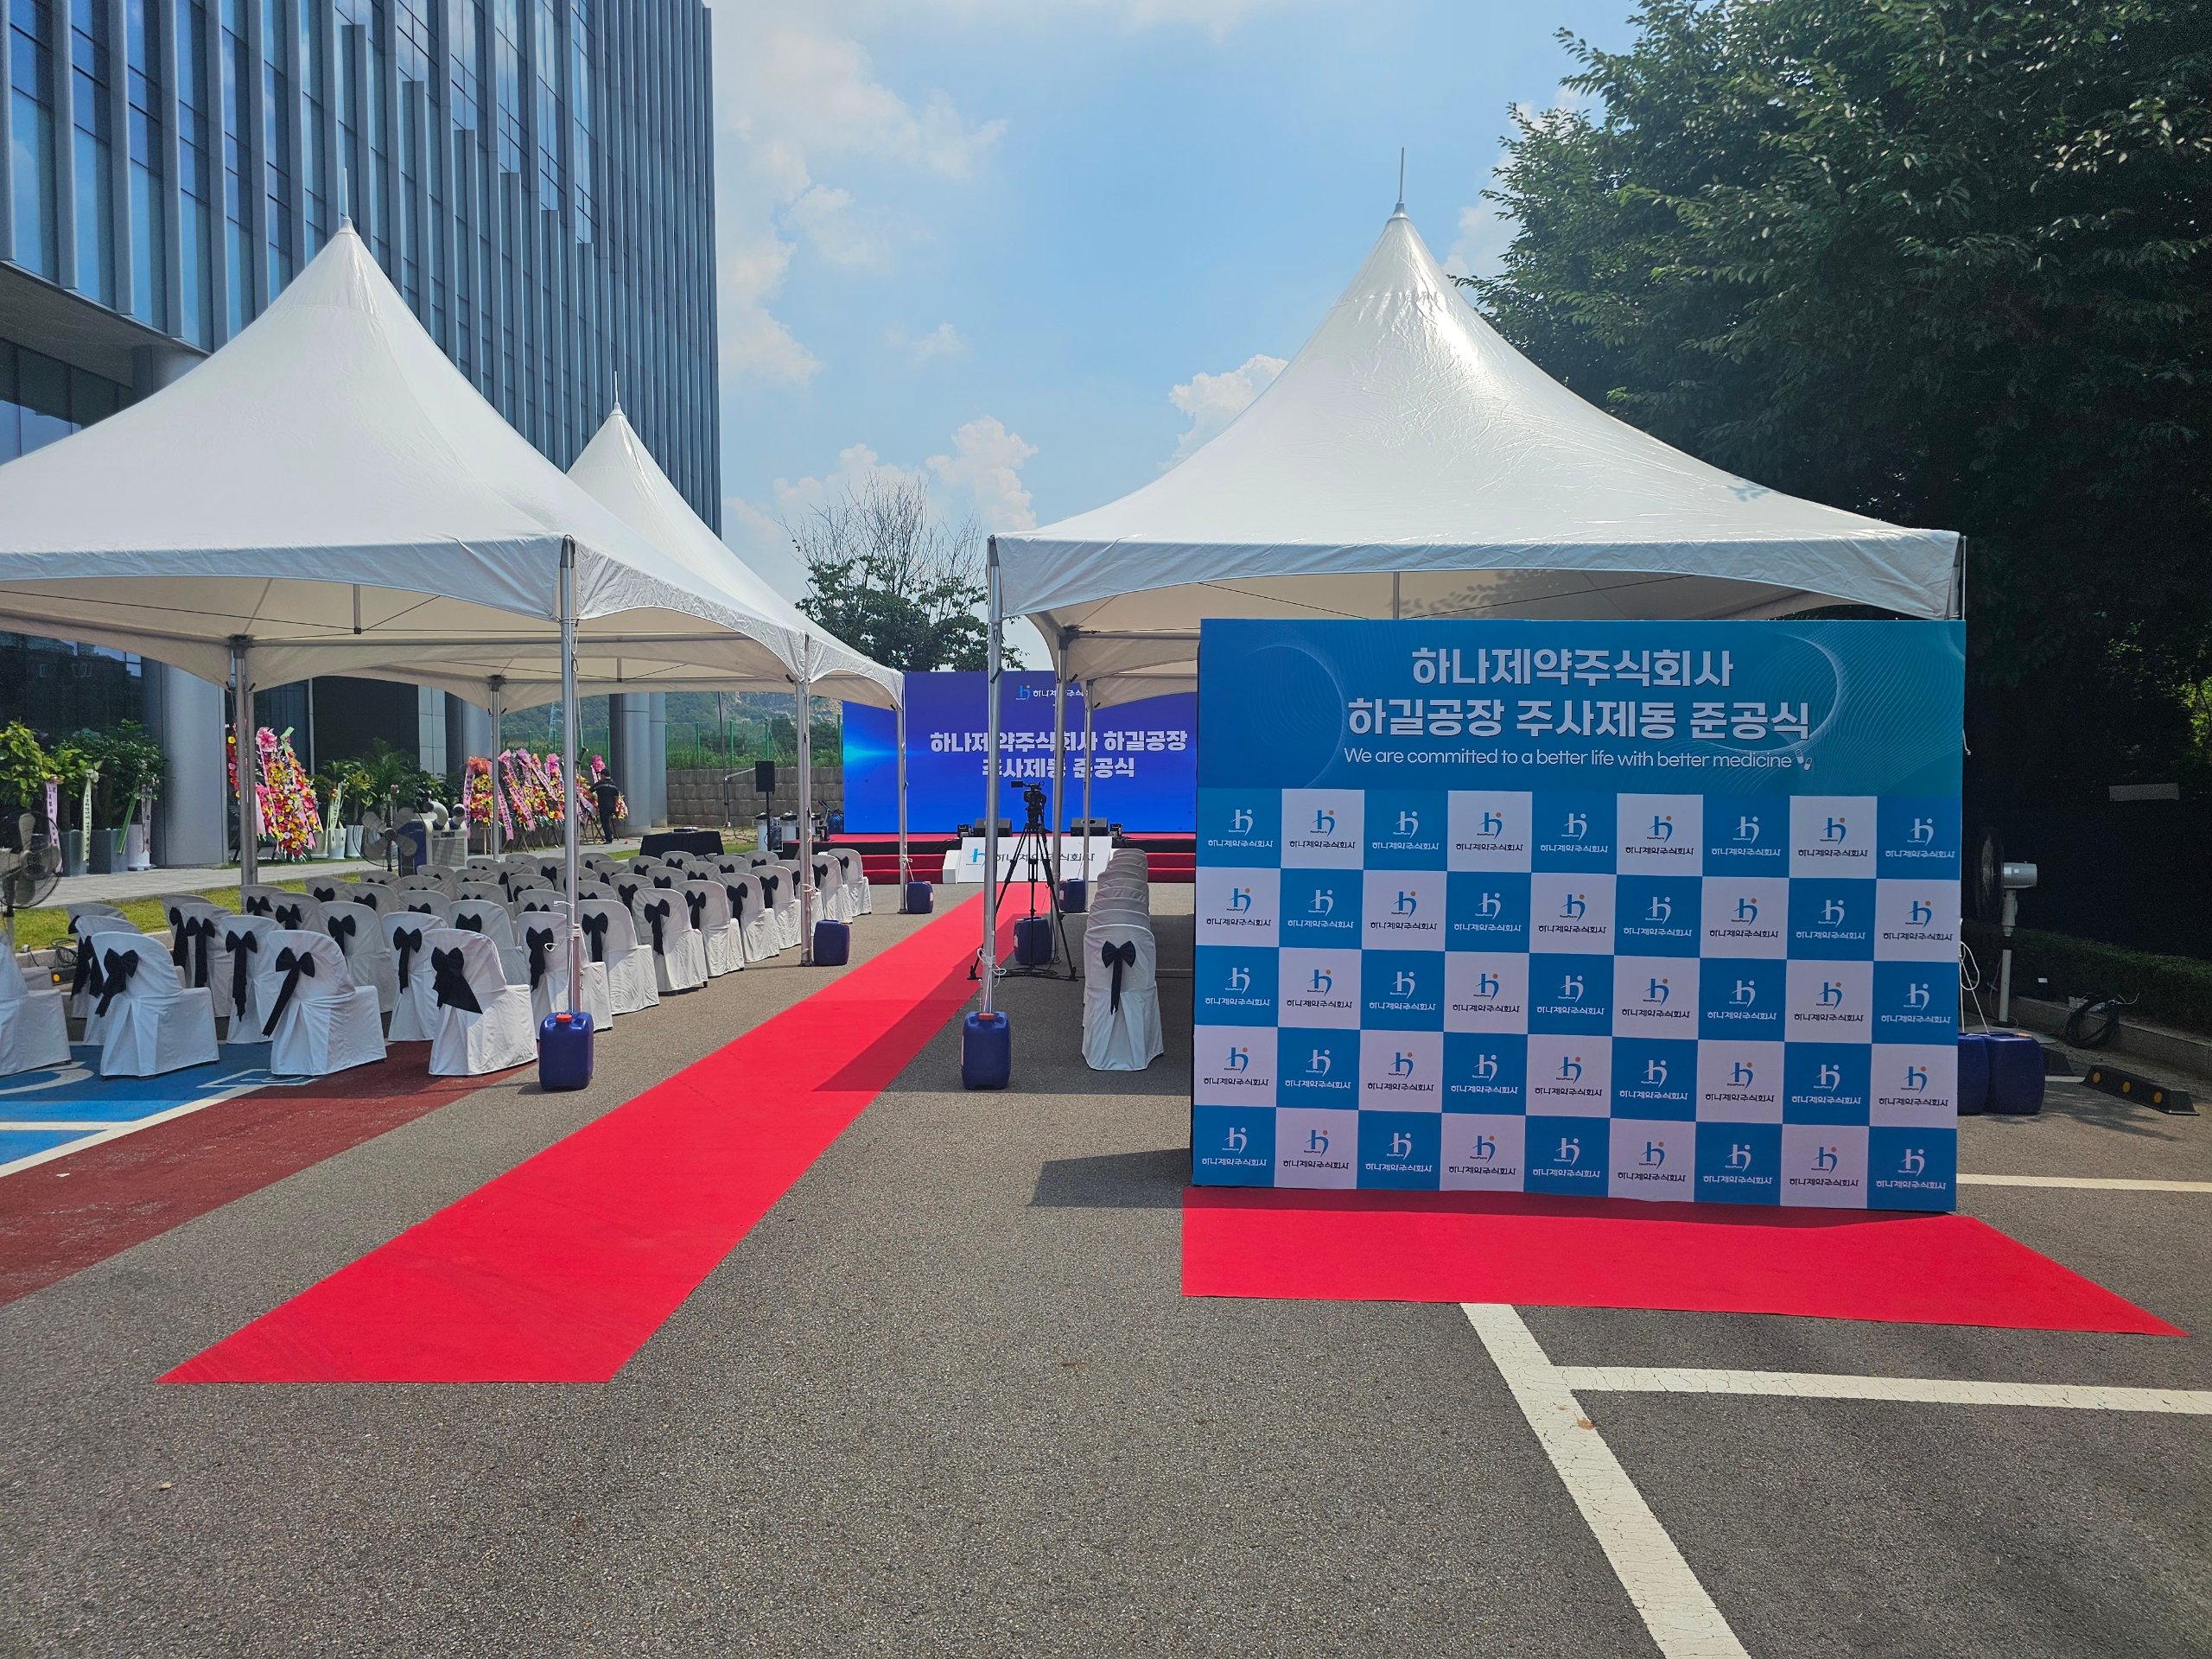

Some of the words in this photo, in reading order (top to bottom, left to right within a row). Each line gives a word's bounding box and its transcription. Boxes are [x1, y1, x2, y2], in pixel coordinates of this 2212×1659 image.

[1411, 646, 1734, 687] 하나제약주식회사
[1348, 697, 1505, 737] 하길공장
[1516, 700, 1676, 740] 주사제동
[1690, 701, 1809, 741] 준공식
[1103, 730, 1188, 752] 하길공장
[1344, 747, 1372, 763] We
[1375, 751, 1404, 764] are
[1408, 747, 1498, 765] committed
[1501, 749, 1518, 765] to
[1521, 752, 1533, 765] a
[1536, 748, 1588, 766] better
[1591, 749, 1615, 766] life
[1618, 750, 1654, 766] with
[1657, 751, 1711, 767] better
[1713, 751, 1793, 768] medicine
[1207, 839, 1274, 848] 하나제약주식회사
[1289, 840, 1356, 849] 하나제약주식회사
[1371, 842, 1440, 850] 하나제약주식회사
[1540, 844, 1609, 854] 하나제약주식회사
[1624, 846, 1694, 855] 하나제약주식회사
[1711, 848, 1782, 856] 하나제약주식회사
[1885, 849, 1955, 859] 하나제약주식회사
[1206, 918, 1272, 926] 하나제약주식회사
[1287, 919, 1355, 929] 하나제약주식회사
[1370, 922, 1438, 931] 하나제약주식회사
[1453, 923, 1522, 932] 하나제약주식회사
[1538, 925, 1607, 934] 하나제약주식회사
[1623, 927, 1693, 937] 하나제약주식회사
[1709, 930, 1779, 938] 하나제약주식회사
[1796, 931, 1866, 940] 하나제약주식회사
[1883, 932, 1954, 941] 하나제약주식회사
[1205, 997, 1271, 1007] 하나제약주식회사
[1286, 999, 1353, 1008] 하나제약주식회사
[1369, 1001, 1436, 1011] 하나제약주식회사
[1452, 1004, 1521, 1013] 하나제약주식회사
[1536, 1006, 1605, 1015] 하나제약주식회사
[1621, 1008, 1691, 1019] 하나제약주식회사
[1707, 1011, 1777, 1020] 하나제약주식회사
[1793, 1013, 1864, 1022] 하나제약주식회사
[1880, 1014, 1952, 1024] 하나제약주식회사
[1203, 1077, 1269, 1086] 하나제약주식회사
[1285, 1079, 1351, 1089] 하나제약주식회사
[1367, 1082, 1434, 1091] 하나제약주식회사
[1450, 1084, 1519, 1094] 하나제약주식회사
[1535, 1087, 1603, 1096] 하나제약주식회사
[1618, 1090, 1688, 1100] 하나제약주식회사
[1705, 1093, 1775, 1103] 하나제약주식회사
[1791, 1096, 1862, 1104] 하나제약주식회사
[1878, 1097, 1949, 1107] 하나제약주식회사
[1201, 1157, 1268, 1166] 하나제약주식회사
[1282, 1160, 1350, 1170] 하나제약주식회사
[1364, 1163, 1433, 1173] 하나제약주식회사
[1448, 1166, 1516, 1175] 하나제약주식회사
[1532, 1168, 1601, 1178] 하나제약주식회사
[1617, 1172, 1687, 1182] 하나제약주식회사
[1702, 1175, 1773, 1185] 하나제약주식회사
[1789, 1178, 1859, 1187] 하나제약주식회사
[1875, 1179, 1947, 1190] 하나제약주식회사
